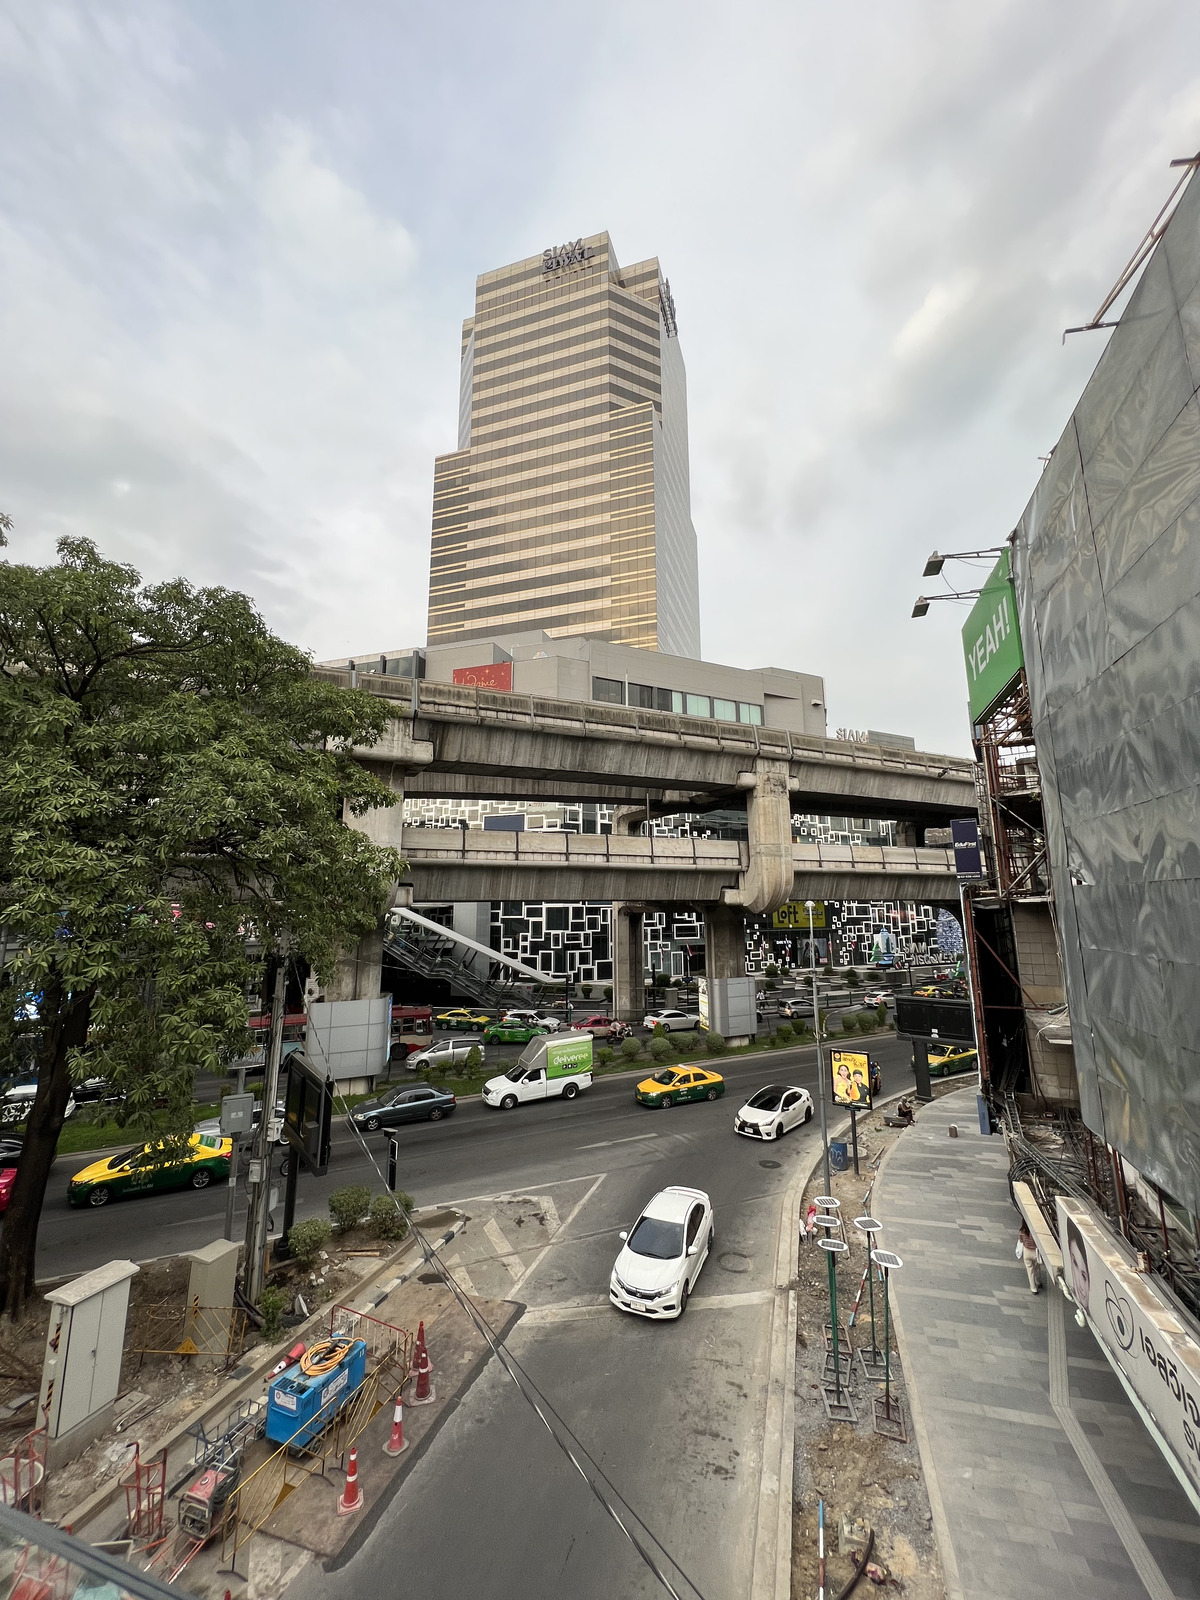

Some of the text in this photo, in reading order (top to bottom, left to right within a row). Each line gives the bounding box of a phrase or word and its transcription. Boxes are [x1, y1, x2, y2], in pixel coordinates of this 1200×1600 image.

[542, 238, 583, 261] SIAM
[968, 596, 1011, 681] YEAH!
[836, 727, 866, 743] SIAM
[777, 904, 799, 924] Loft
[553, 1052, 589, 1066] deliveree
